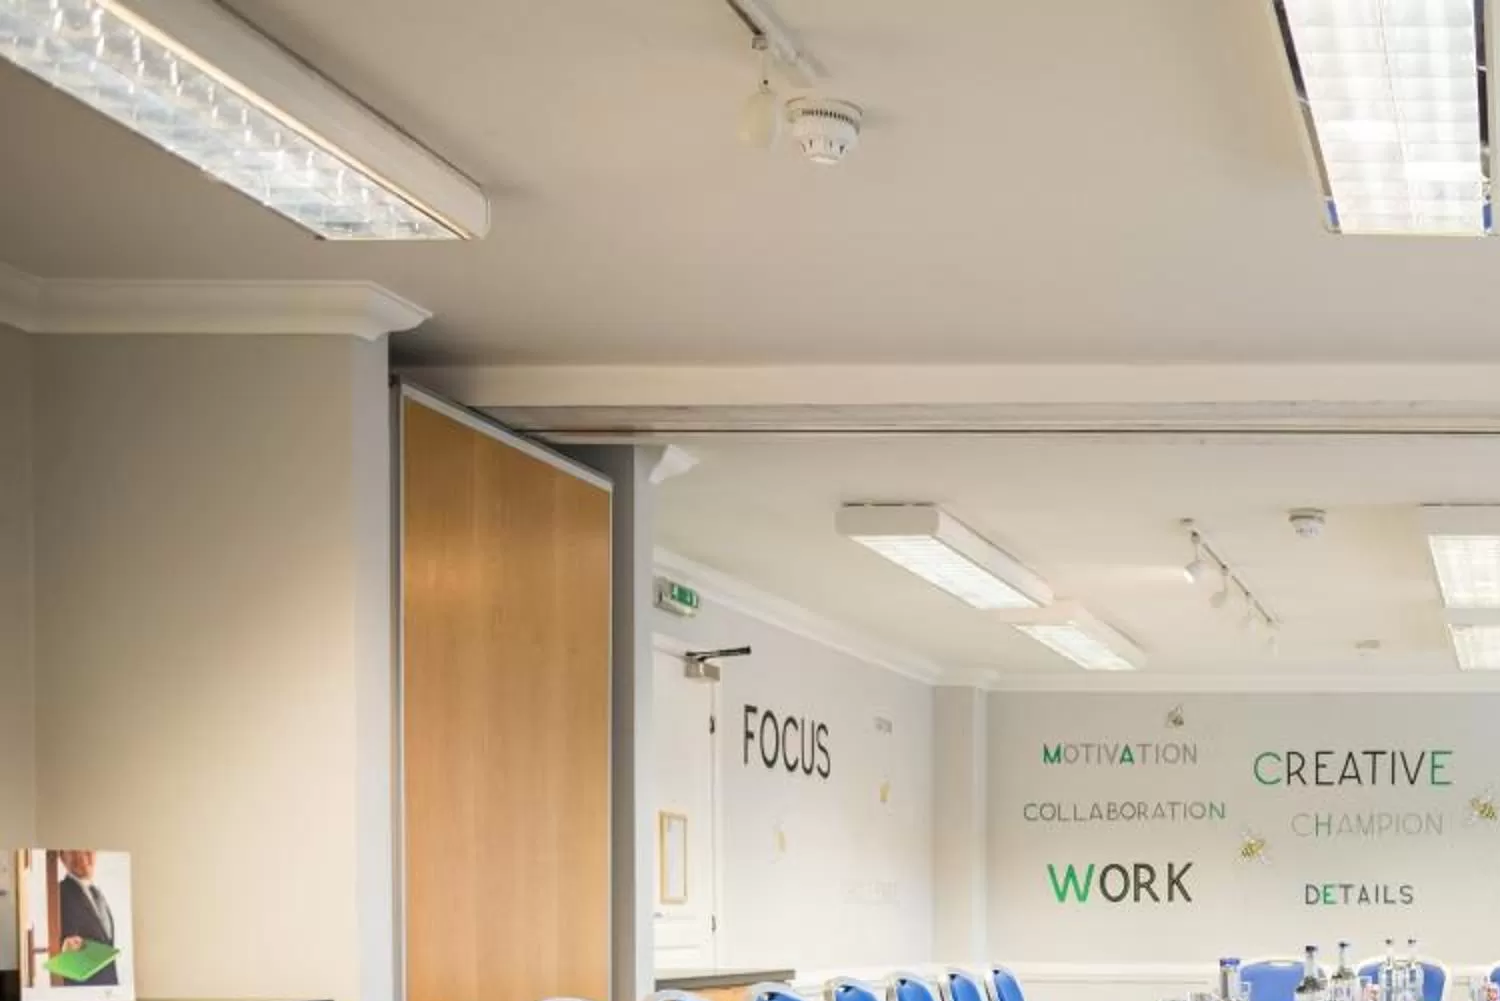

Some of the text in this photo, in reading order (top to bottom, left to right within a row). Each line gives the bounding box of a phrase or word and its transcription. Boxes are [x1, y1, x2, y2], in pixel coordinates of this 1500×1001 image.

[743, 704, 831, 779] FOCUS
[1042, 743, 1198, 765] MOTIVATION
[1253, 750, 1454, 786] CREATIVE
[1023, 801, 1226, 823] COLLABORATION
[1291, 812, 1444, 839] CHAMPION
[1047, 862, 1194, 903] WORK
[1304, 883, 1415, 906] DETAILS
